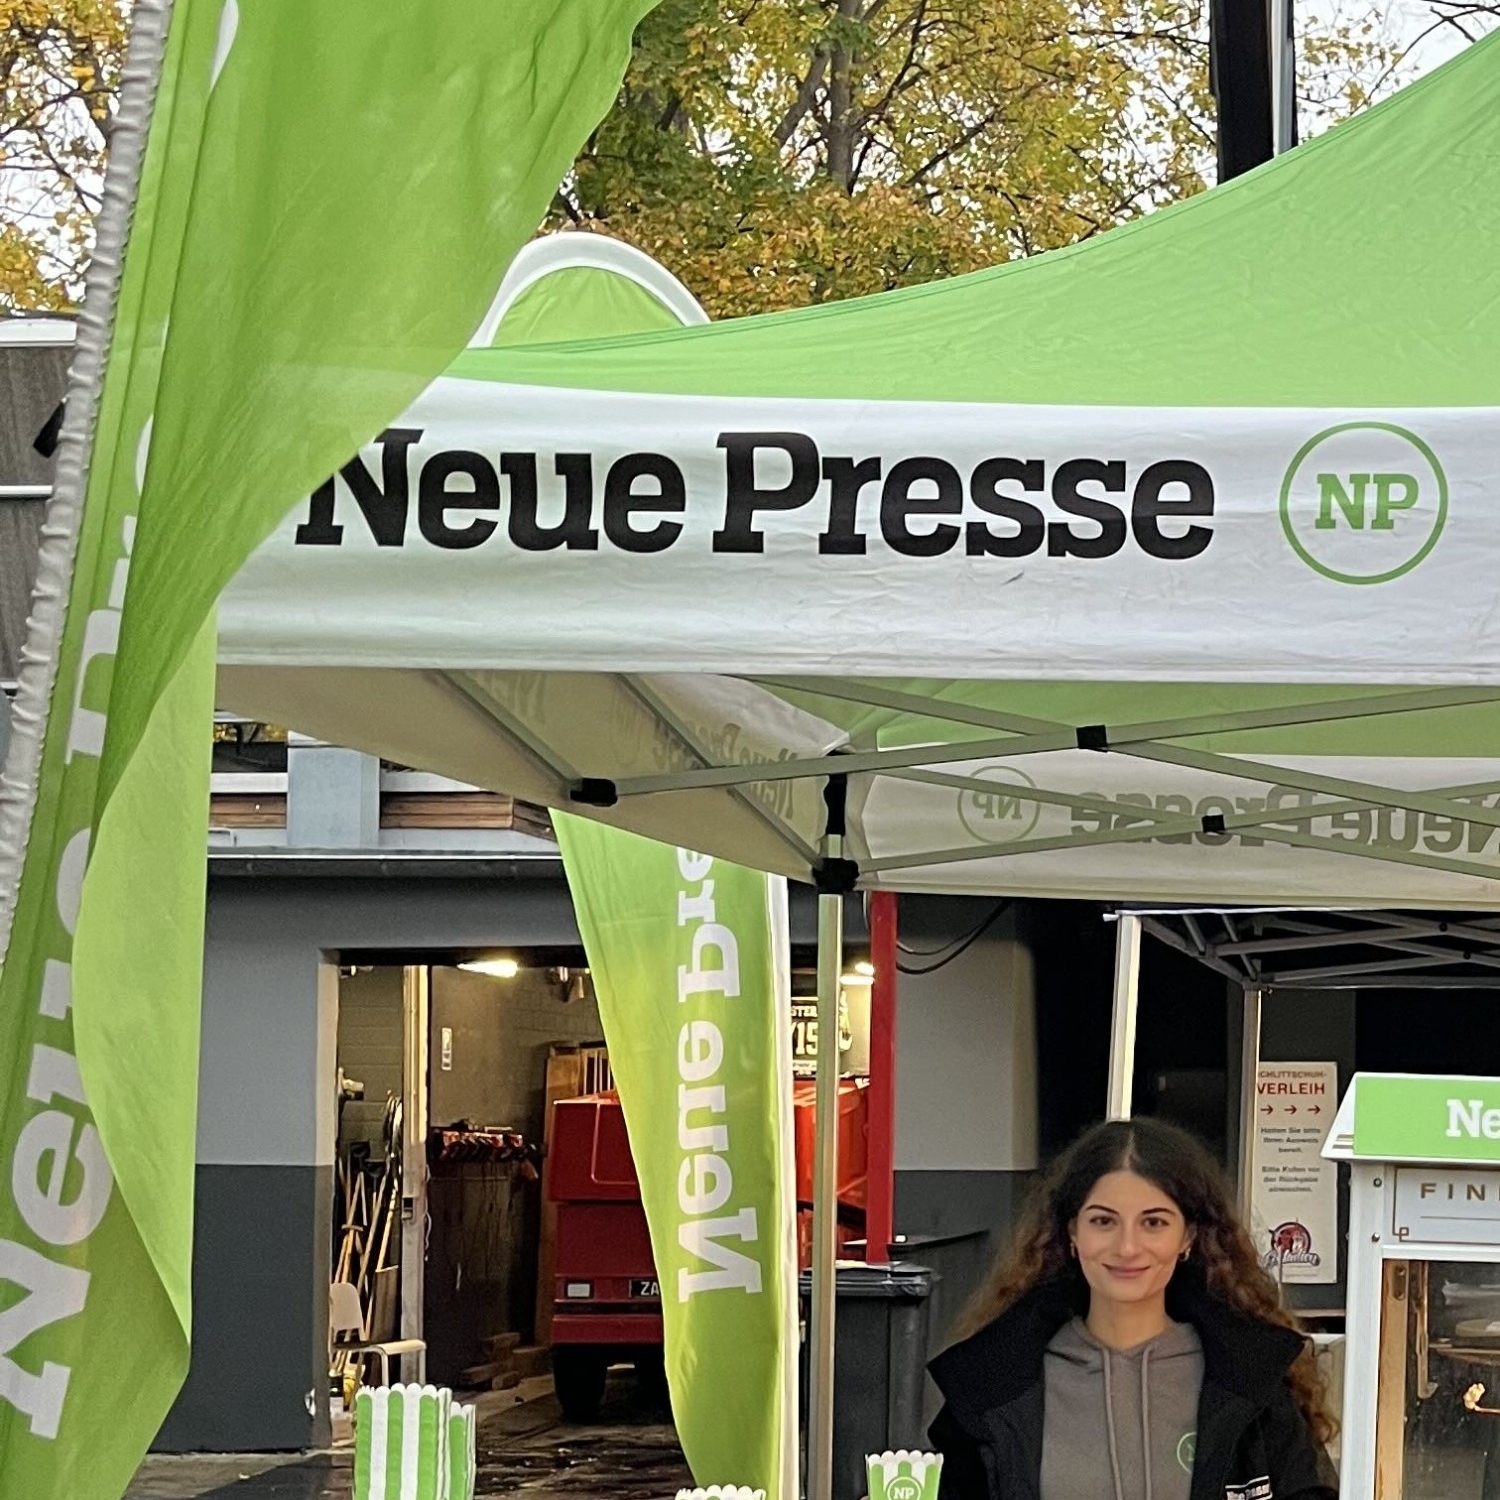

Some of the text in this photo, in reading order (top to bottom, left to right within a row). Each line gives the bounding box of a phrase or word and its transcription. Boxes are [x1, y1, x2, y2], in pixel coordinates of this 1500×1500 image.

[295, 427, 1419, 560] Neue Presse NP
[1257, 1082, 1325, 1095] VERLEIH
[893, 1486, 915, 1500] NP
